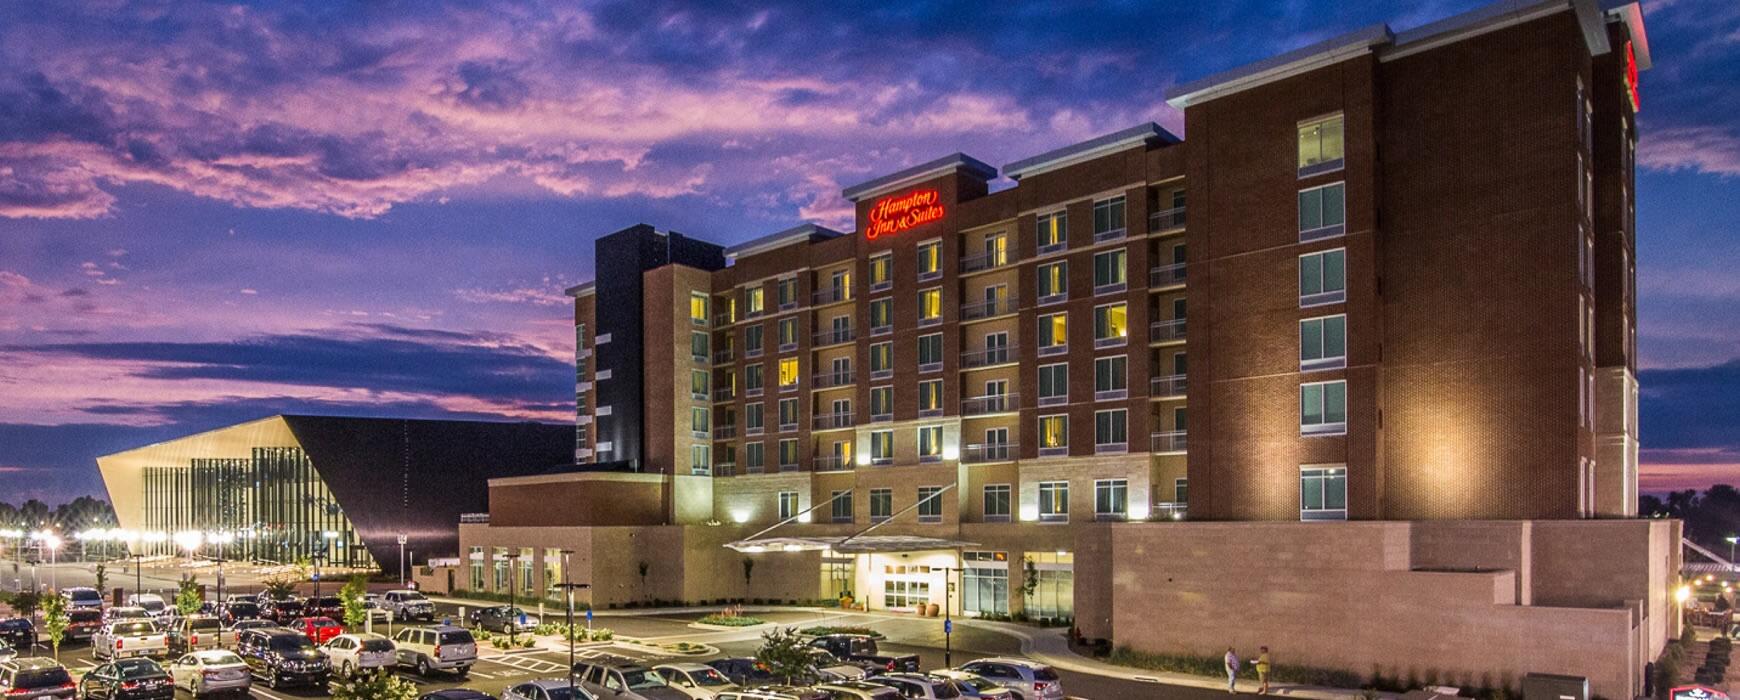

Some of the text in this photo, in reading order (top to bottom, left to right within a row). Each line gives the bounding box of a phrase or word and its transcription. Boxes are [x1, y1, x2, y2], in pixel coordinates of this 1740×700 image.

[869, 190, 938, 220] Hampton
[866, 218, 899, 239] Inn
[906, 205, 944, 226] Suites
